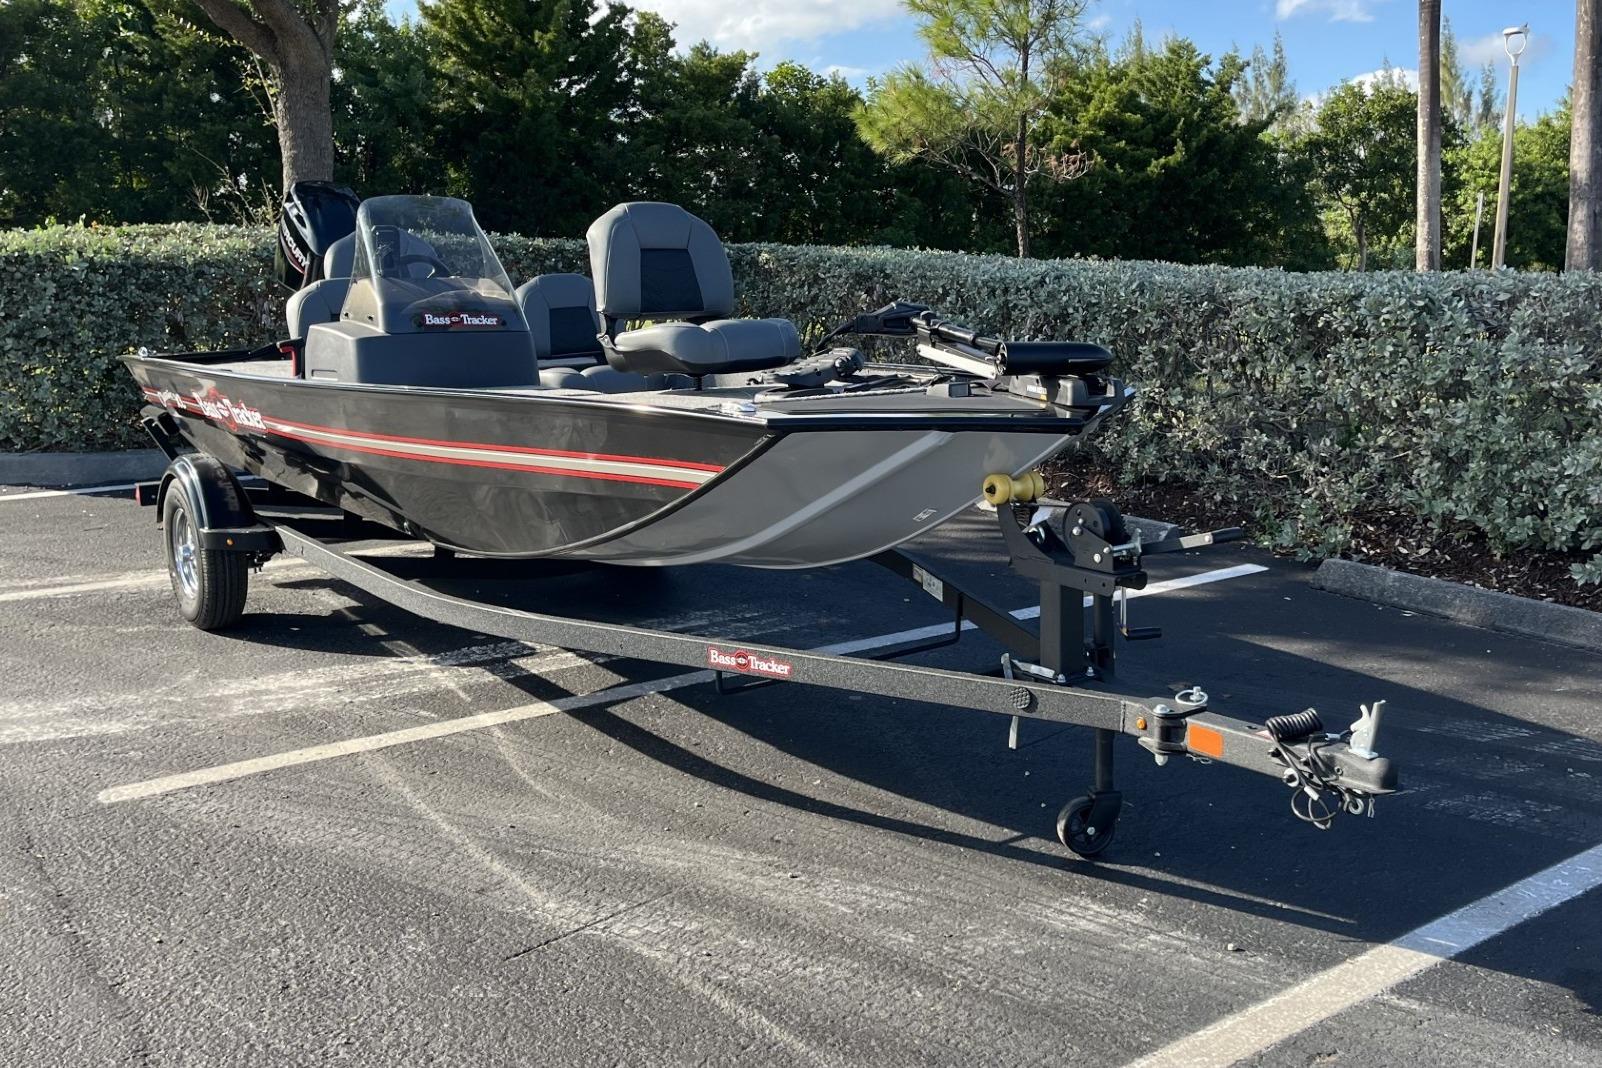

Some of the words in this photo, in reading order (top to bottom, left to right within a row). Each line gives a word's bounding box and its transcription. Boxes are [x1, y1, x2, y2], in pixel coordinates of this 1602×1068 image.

[425, 313, 450, 325] Bass
[460, 313, 498, 325] Tracker
[710, 649, 736, 666] Bass
[748, 655, 790, 675] Tracker
